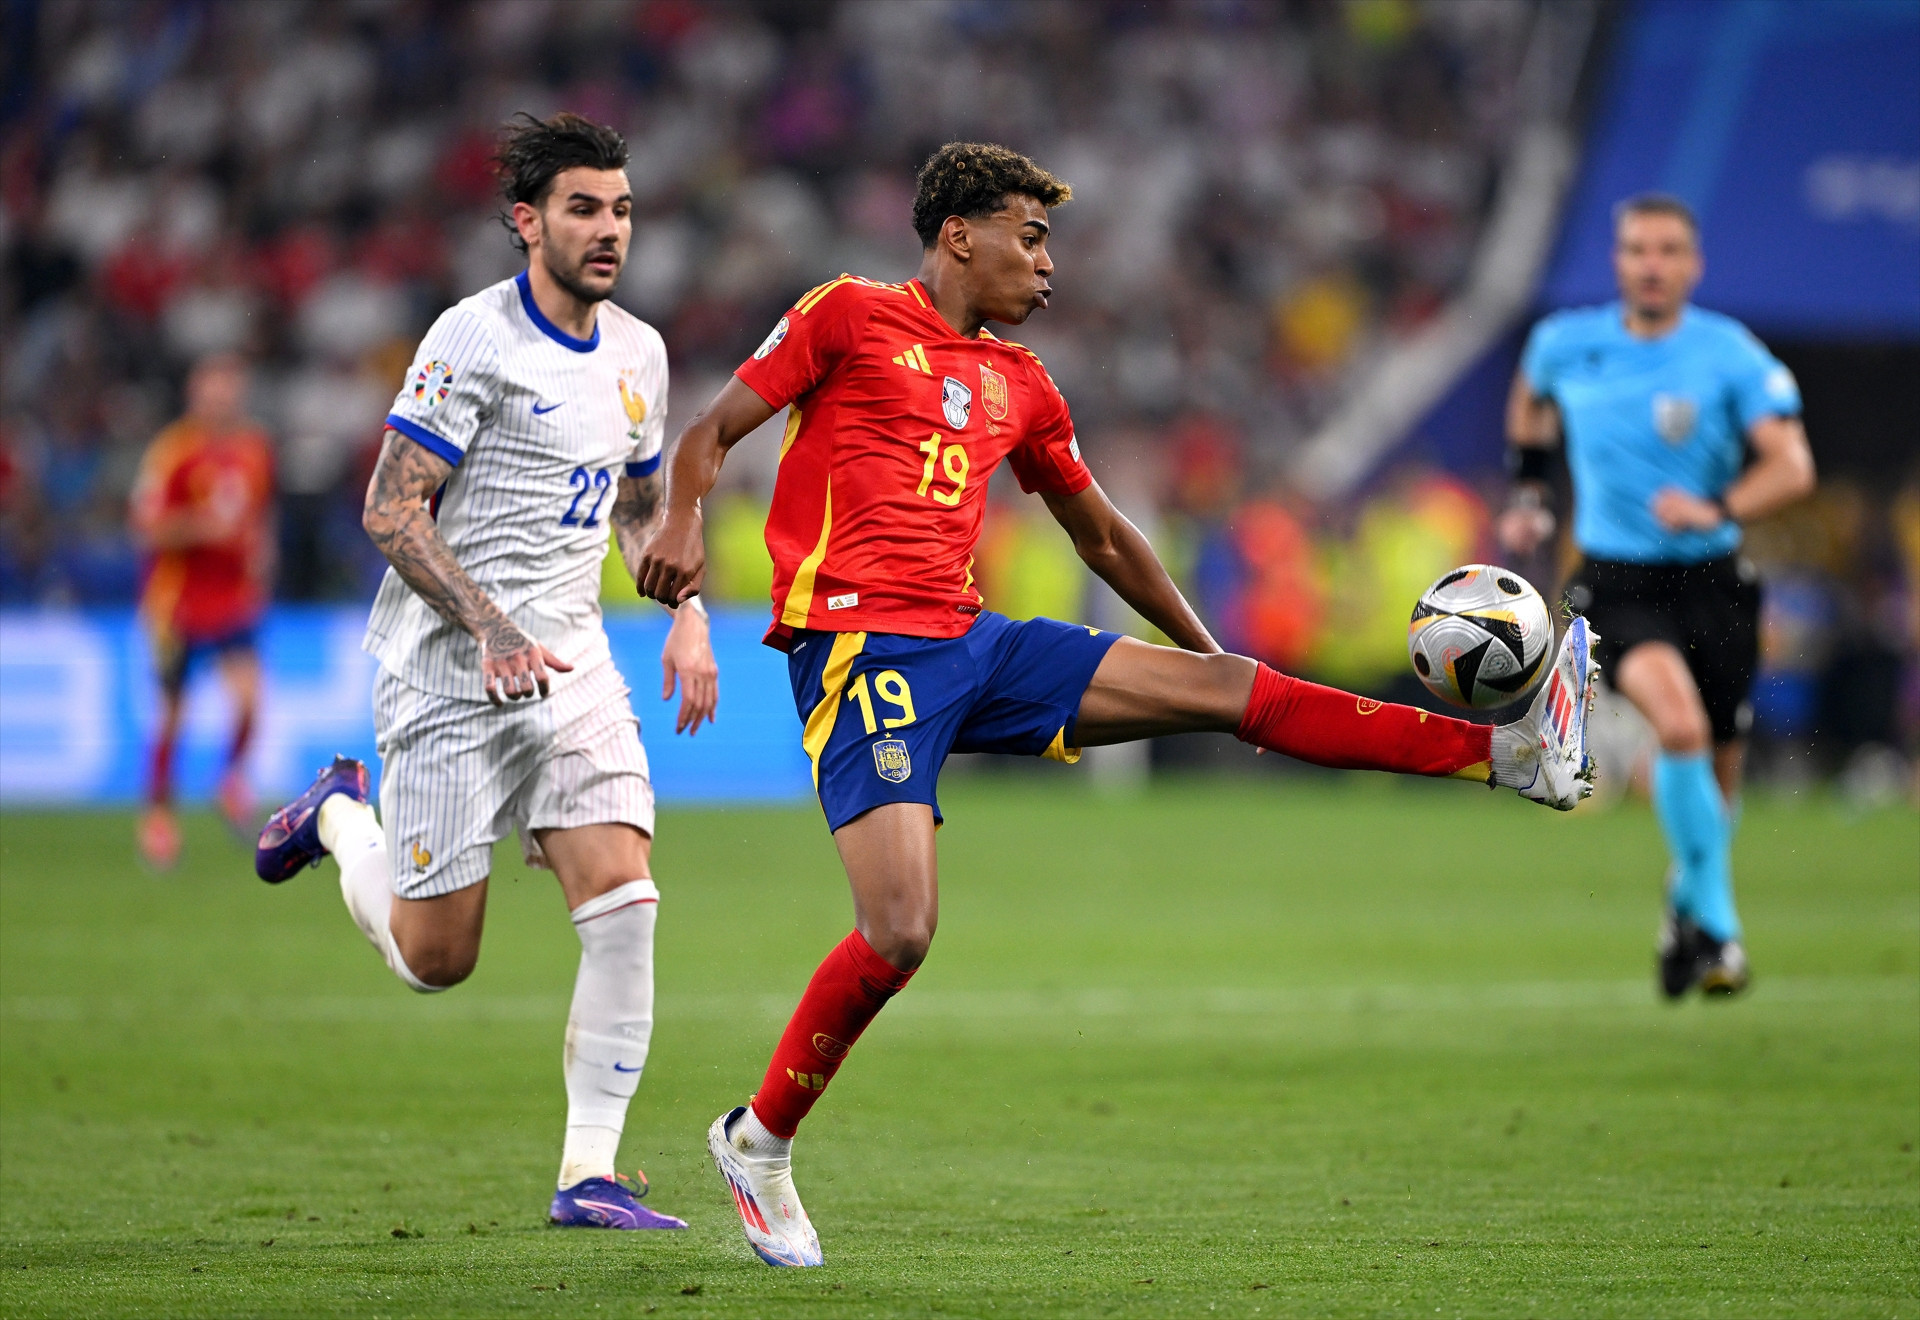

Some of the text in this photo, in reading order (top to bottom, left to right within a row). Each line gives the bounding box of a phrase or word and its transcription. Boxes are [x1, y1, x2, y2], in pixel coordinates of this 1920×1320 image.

[560, 466, 611, 528] 22
[916, 432, 970, 506] 19
[847, 669, 917, 735] 19
[721, 1155, 751, 1193] F50
